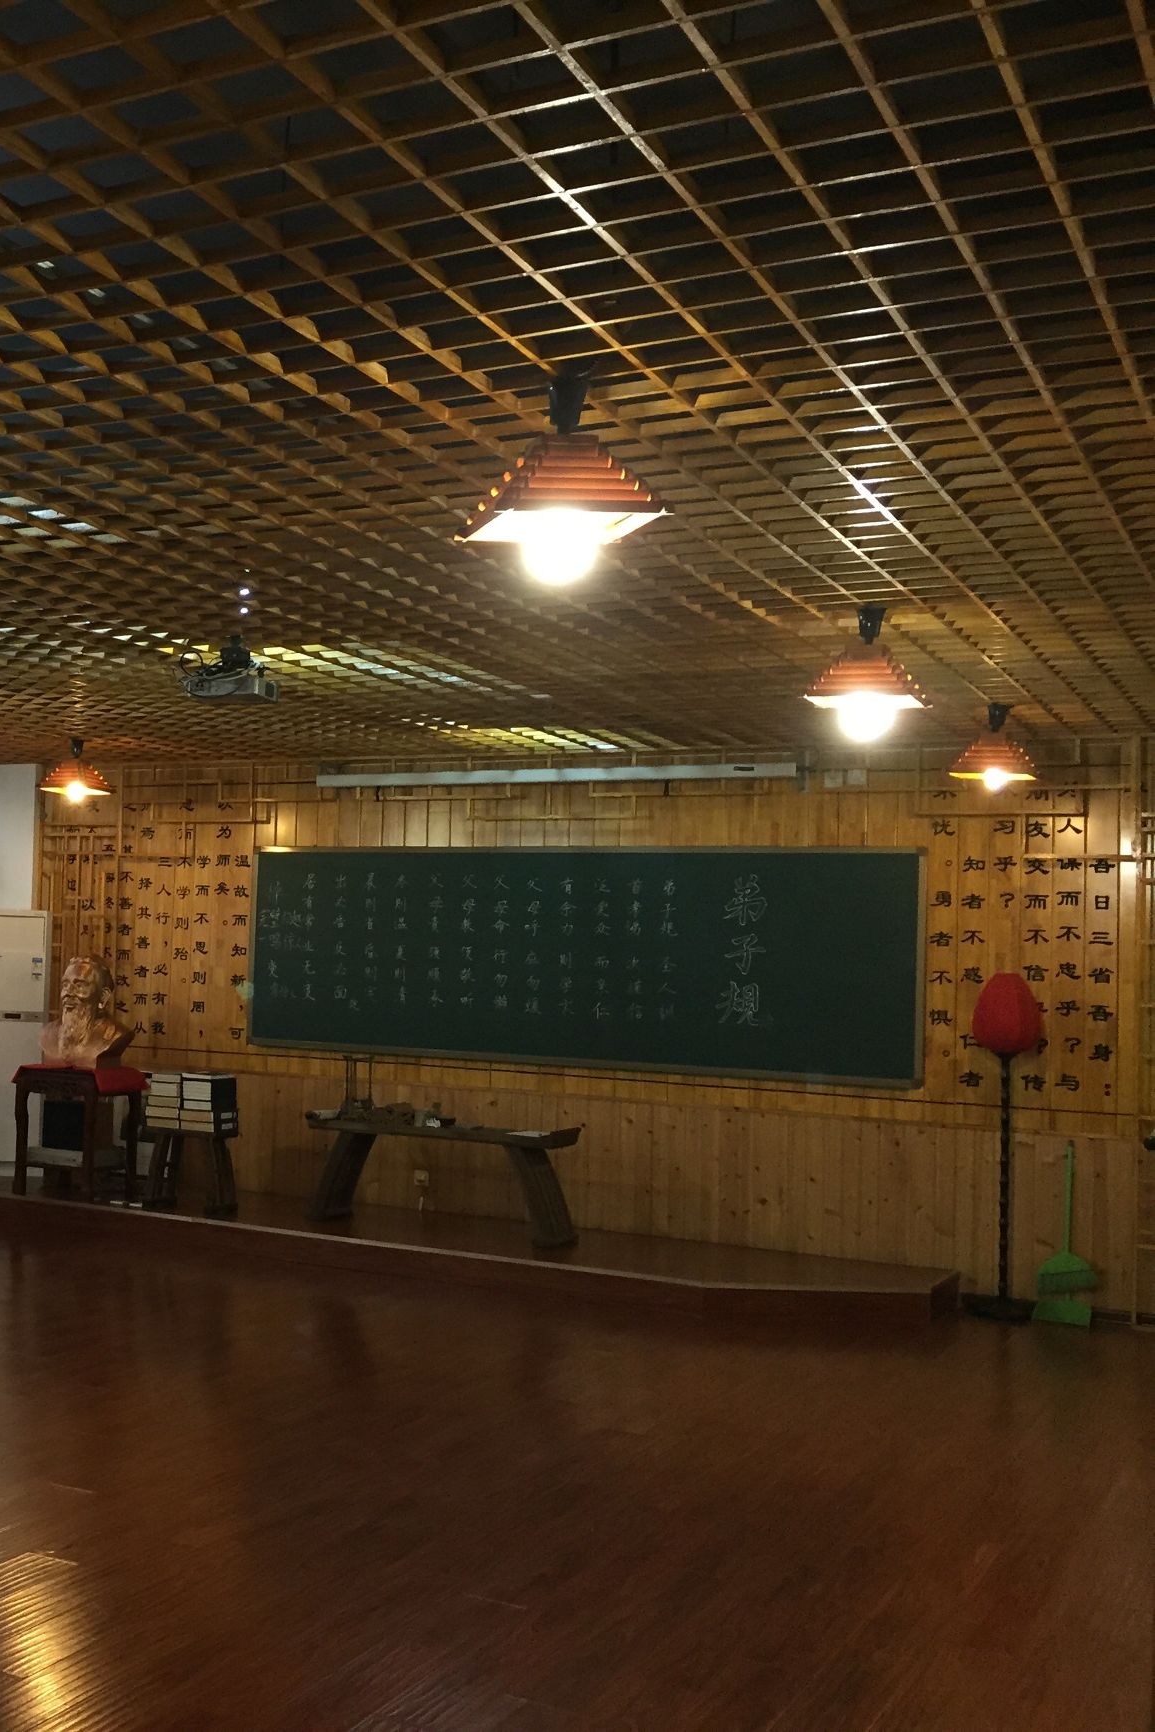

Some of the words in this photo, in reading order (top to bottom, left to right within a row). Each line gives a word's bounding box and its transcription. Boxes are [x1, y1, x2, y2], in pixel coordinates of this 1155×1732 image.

[151, 856, 173, 1036] 三人行，必有我
[229, 854, 251, 1040] 温故而知新，可
